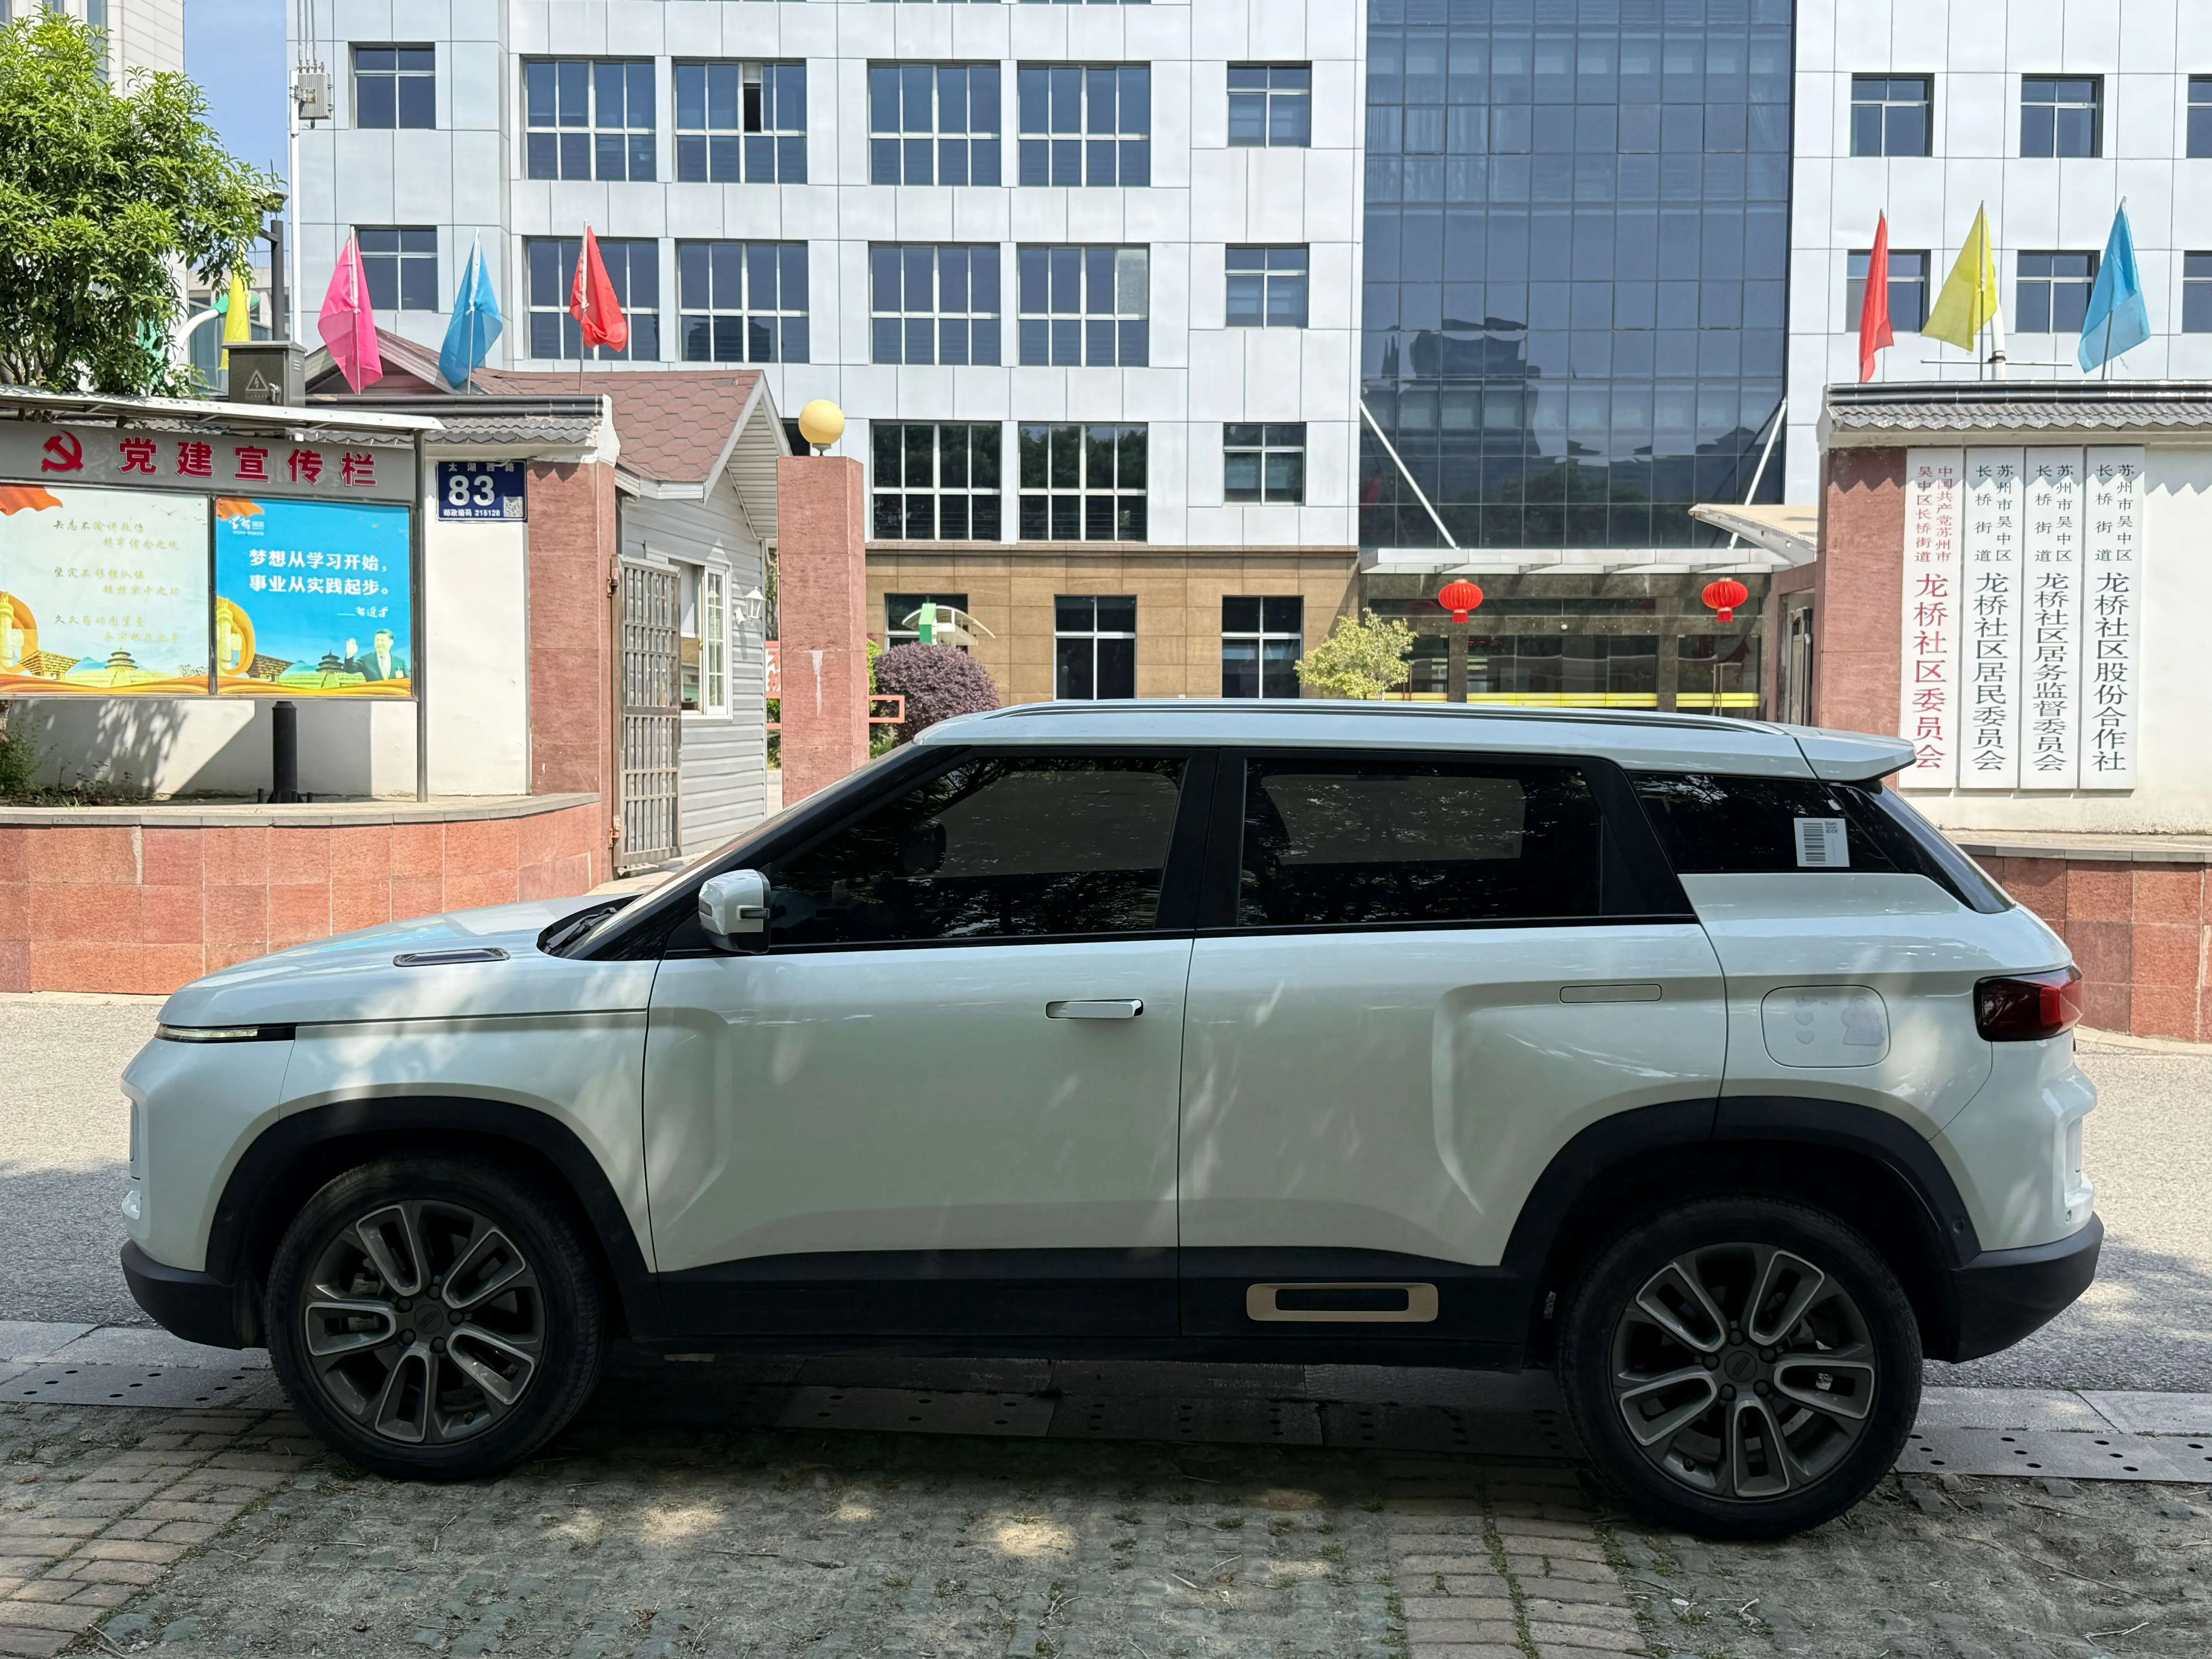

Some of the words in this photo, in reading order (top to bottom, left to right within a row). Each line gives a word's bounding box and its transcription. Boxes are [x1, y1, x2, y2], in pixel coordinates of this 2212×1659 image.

[119, 437, 377, 486] 党建宣传栏
[448, 463, 515, 472] 太湖西路
[449, 475, 495, 506] 83
[249, 549, 387, 572] 梦想从学习开始，
[1914, 466, 1933, 563] 吴中区长桥街道
[1935, 466, 1953, 563] 中国共产党苏州市
[1974, 465, 1992, 562] 长桥街道
[1996, 465, 2013, 562] 苏州市吴中区
[2035, 465, 2052, 562] 长桥街道
[2056, 465, 2073, 562] 苏州市吴中区
[2095, 465, 2112, 562] 长桥街道
[2116, 464, 2134, 562] 苏州市吴中区
[249, 574, 388, 595] 事业从实践起步。
[1912, 573, 1948, 769] 龙桥社区委员会
[1972, 573, 2009, 771] 龙桥社区居民委员会
[2033, 573, 2069, 771] 龙桥社区居务监督委员会
[2091, 572, 2130, 771] 龙桥社区股份合作社
